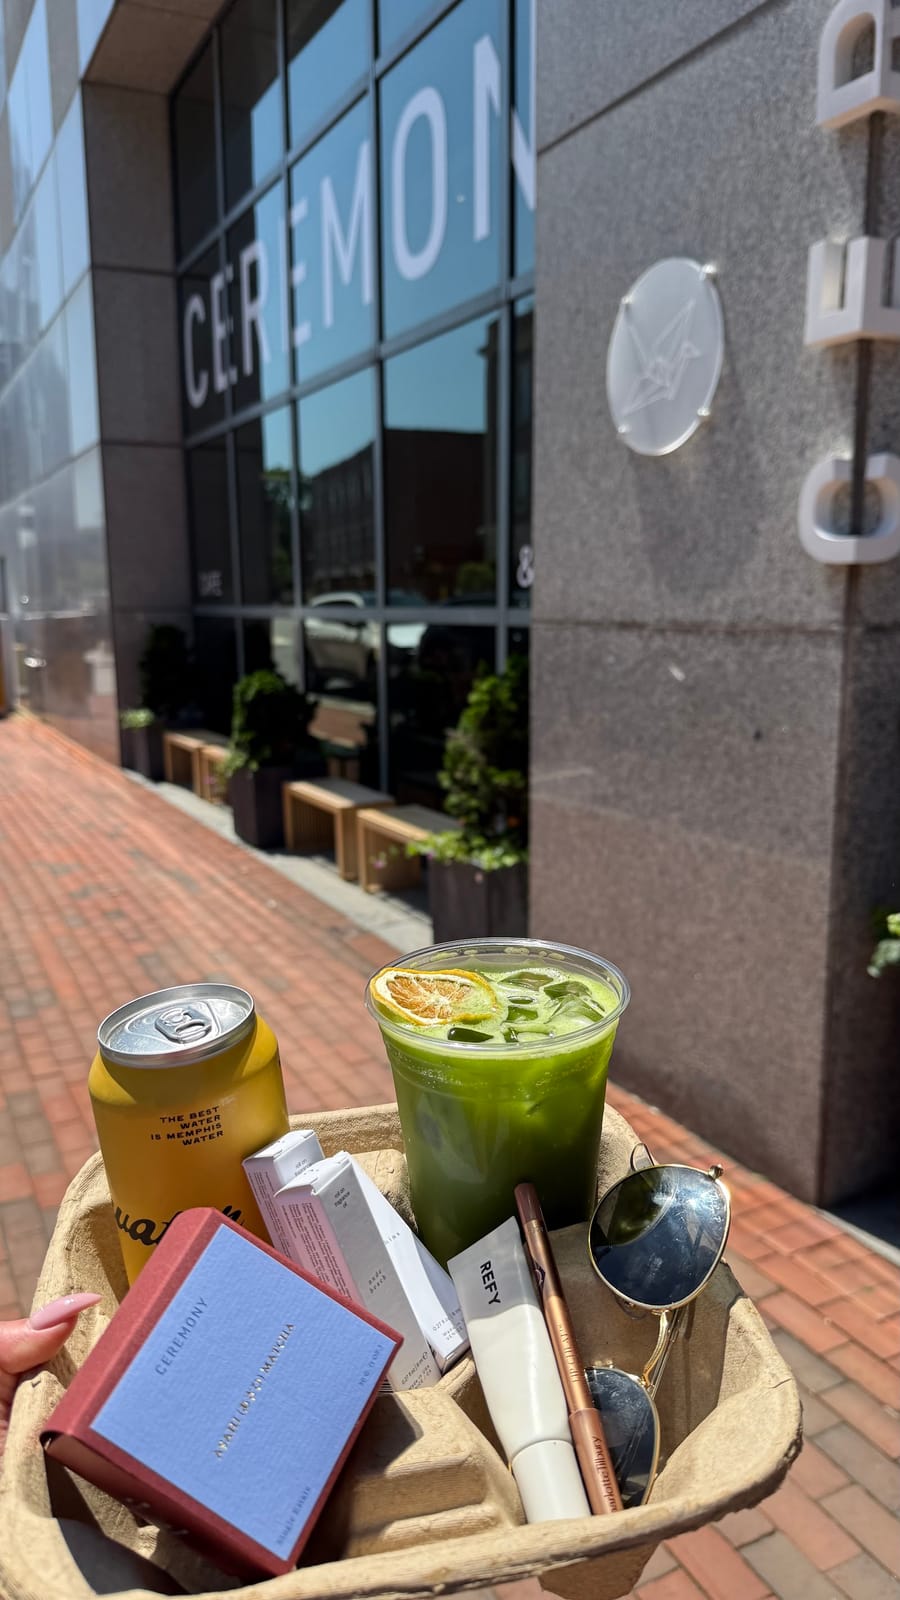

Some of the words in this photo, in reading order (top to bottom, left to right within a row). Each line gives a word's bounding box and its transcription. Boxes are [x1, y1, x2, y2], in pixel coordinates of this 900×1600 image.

[159, 1113, 185, 1125] THE
[189, 1106, 220, 1121] BEST
[180, 1114, 221, 1131] WATER
[150, 1133, 162, 1142] IS
[166, 1123, 222, 1141] MEMPHIS
[182, 1130, 224, 1147] WATER
[480, 1260, 501, 1306] REFY
[154, 1297, 208, 1375] CEREMONY
[214, 1416, 241, 1460] ASAHI
[260, 1323, 294, 1373] MATCHA
